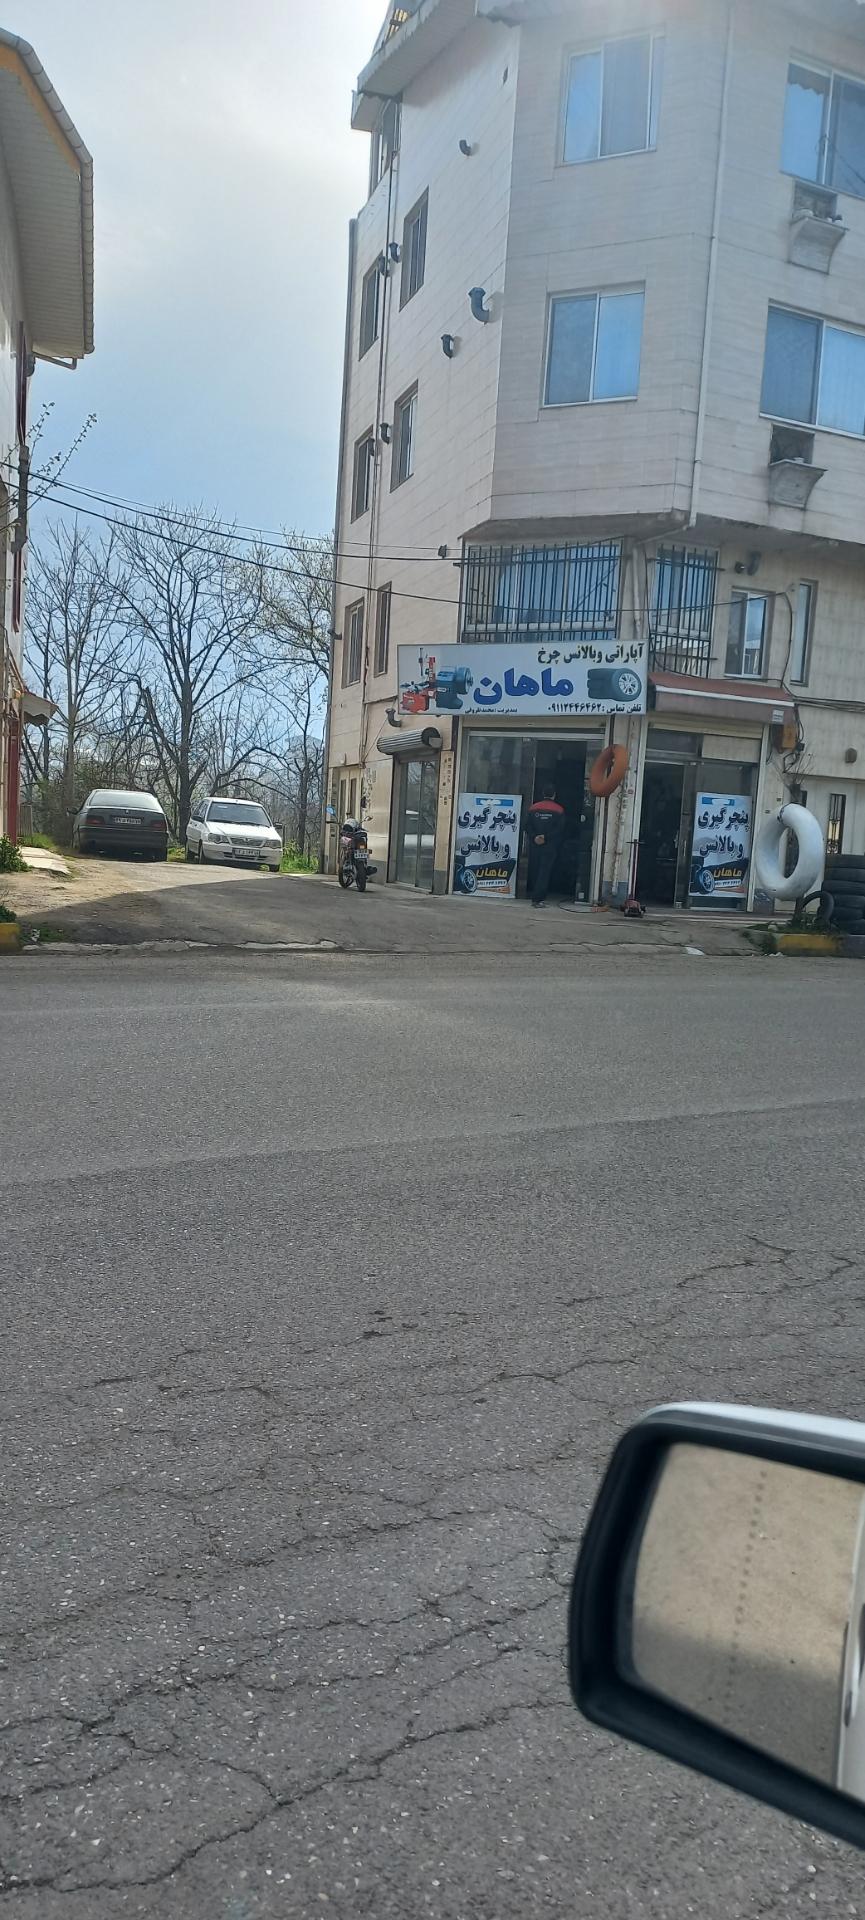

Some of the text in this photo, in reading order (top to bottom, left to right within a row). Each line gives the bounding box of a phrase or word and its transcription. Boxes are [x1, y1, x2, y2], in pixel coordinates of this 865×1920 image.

[538, 647, 560, 665] چرخ
[605, 643, 645, 664] آپاراتی
[473, 668, 574, 705] ماهان
[627, 704, 642, 714] تلفن
[475, 866, 508, 877] ماهان
[714, 866, 742, 877] ماهان
